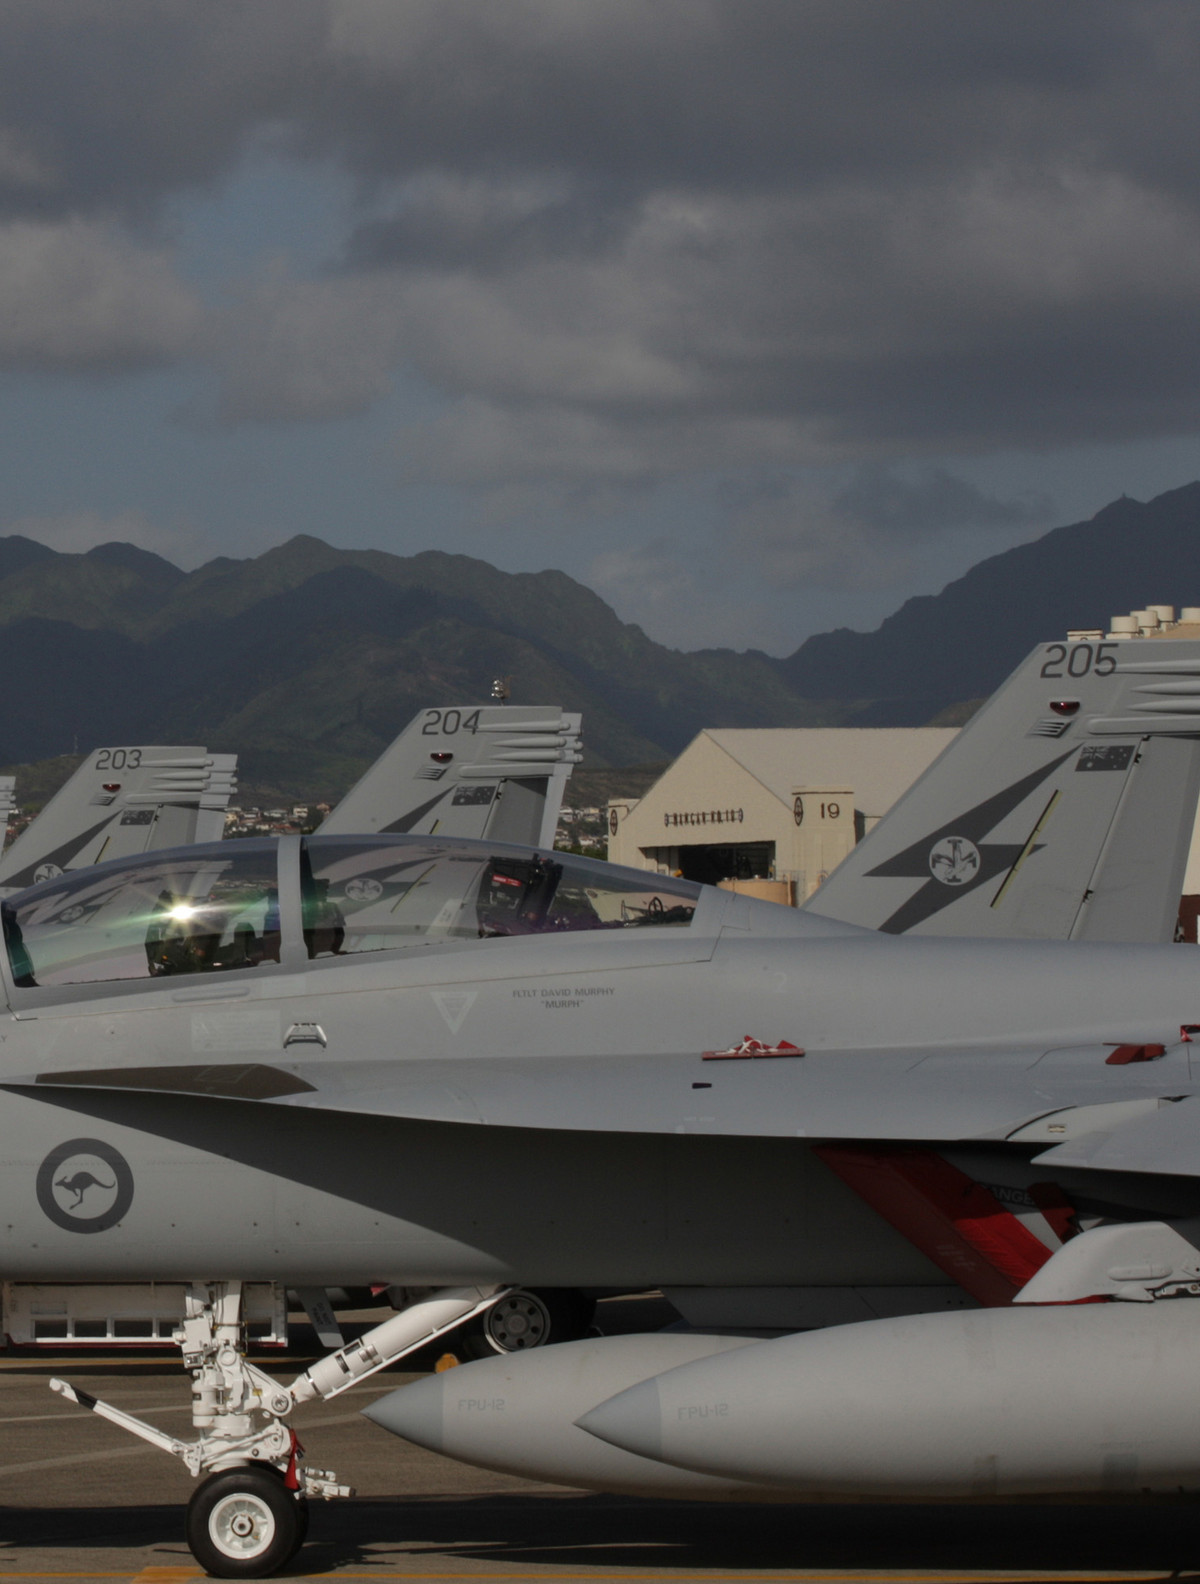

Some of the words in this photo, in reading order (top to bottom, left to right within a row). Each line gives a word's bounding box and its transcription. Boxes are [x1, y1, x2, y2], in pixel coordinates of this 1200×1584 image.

[1040, 643, 1119, 678] 205
[422, 709, 483, 735] 204
[96, 749, 142, 770] 203
[820, 803, 840, 819] 19
[540, 988, 572, 998] DAVID
[574, 987, 616, 997] MURPHY
